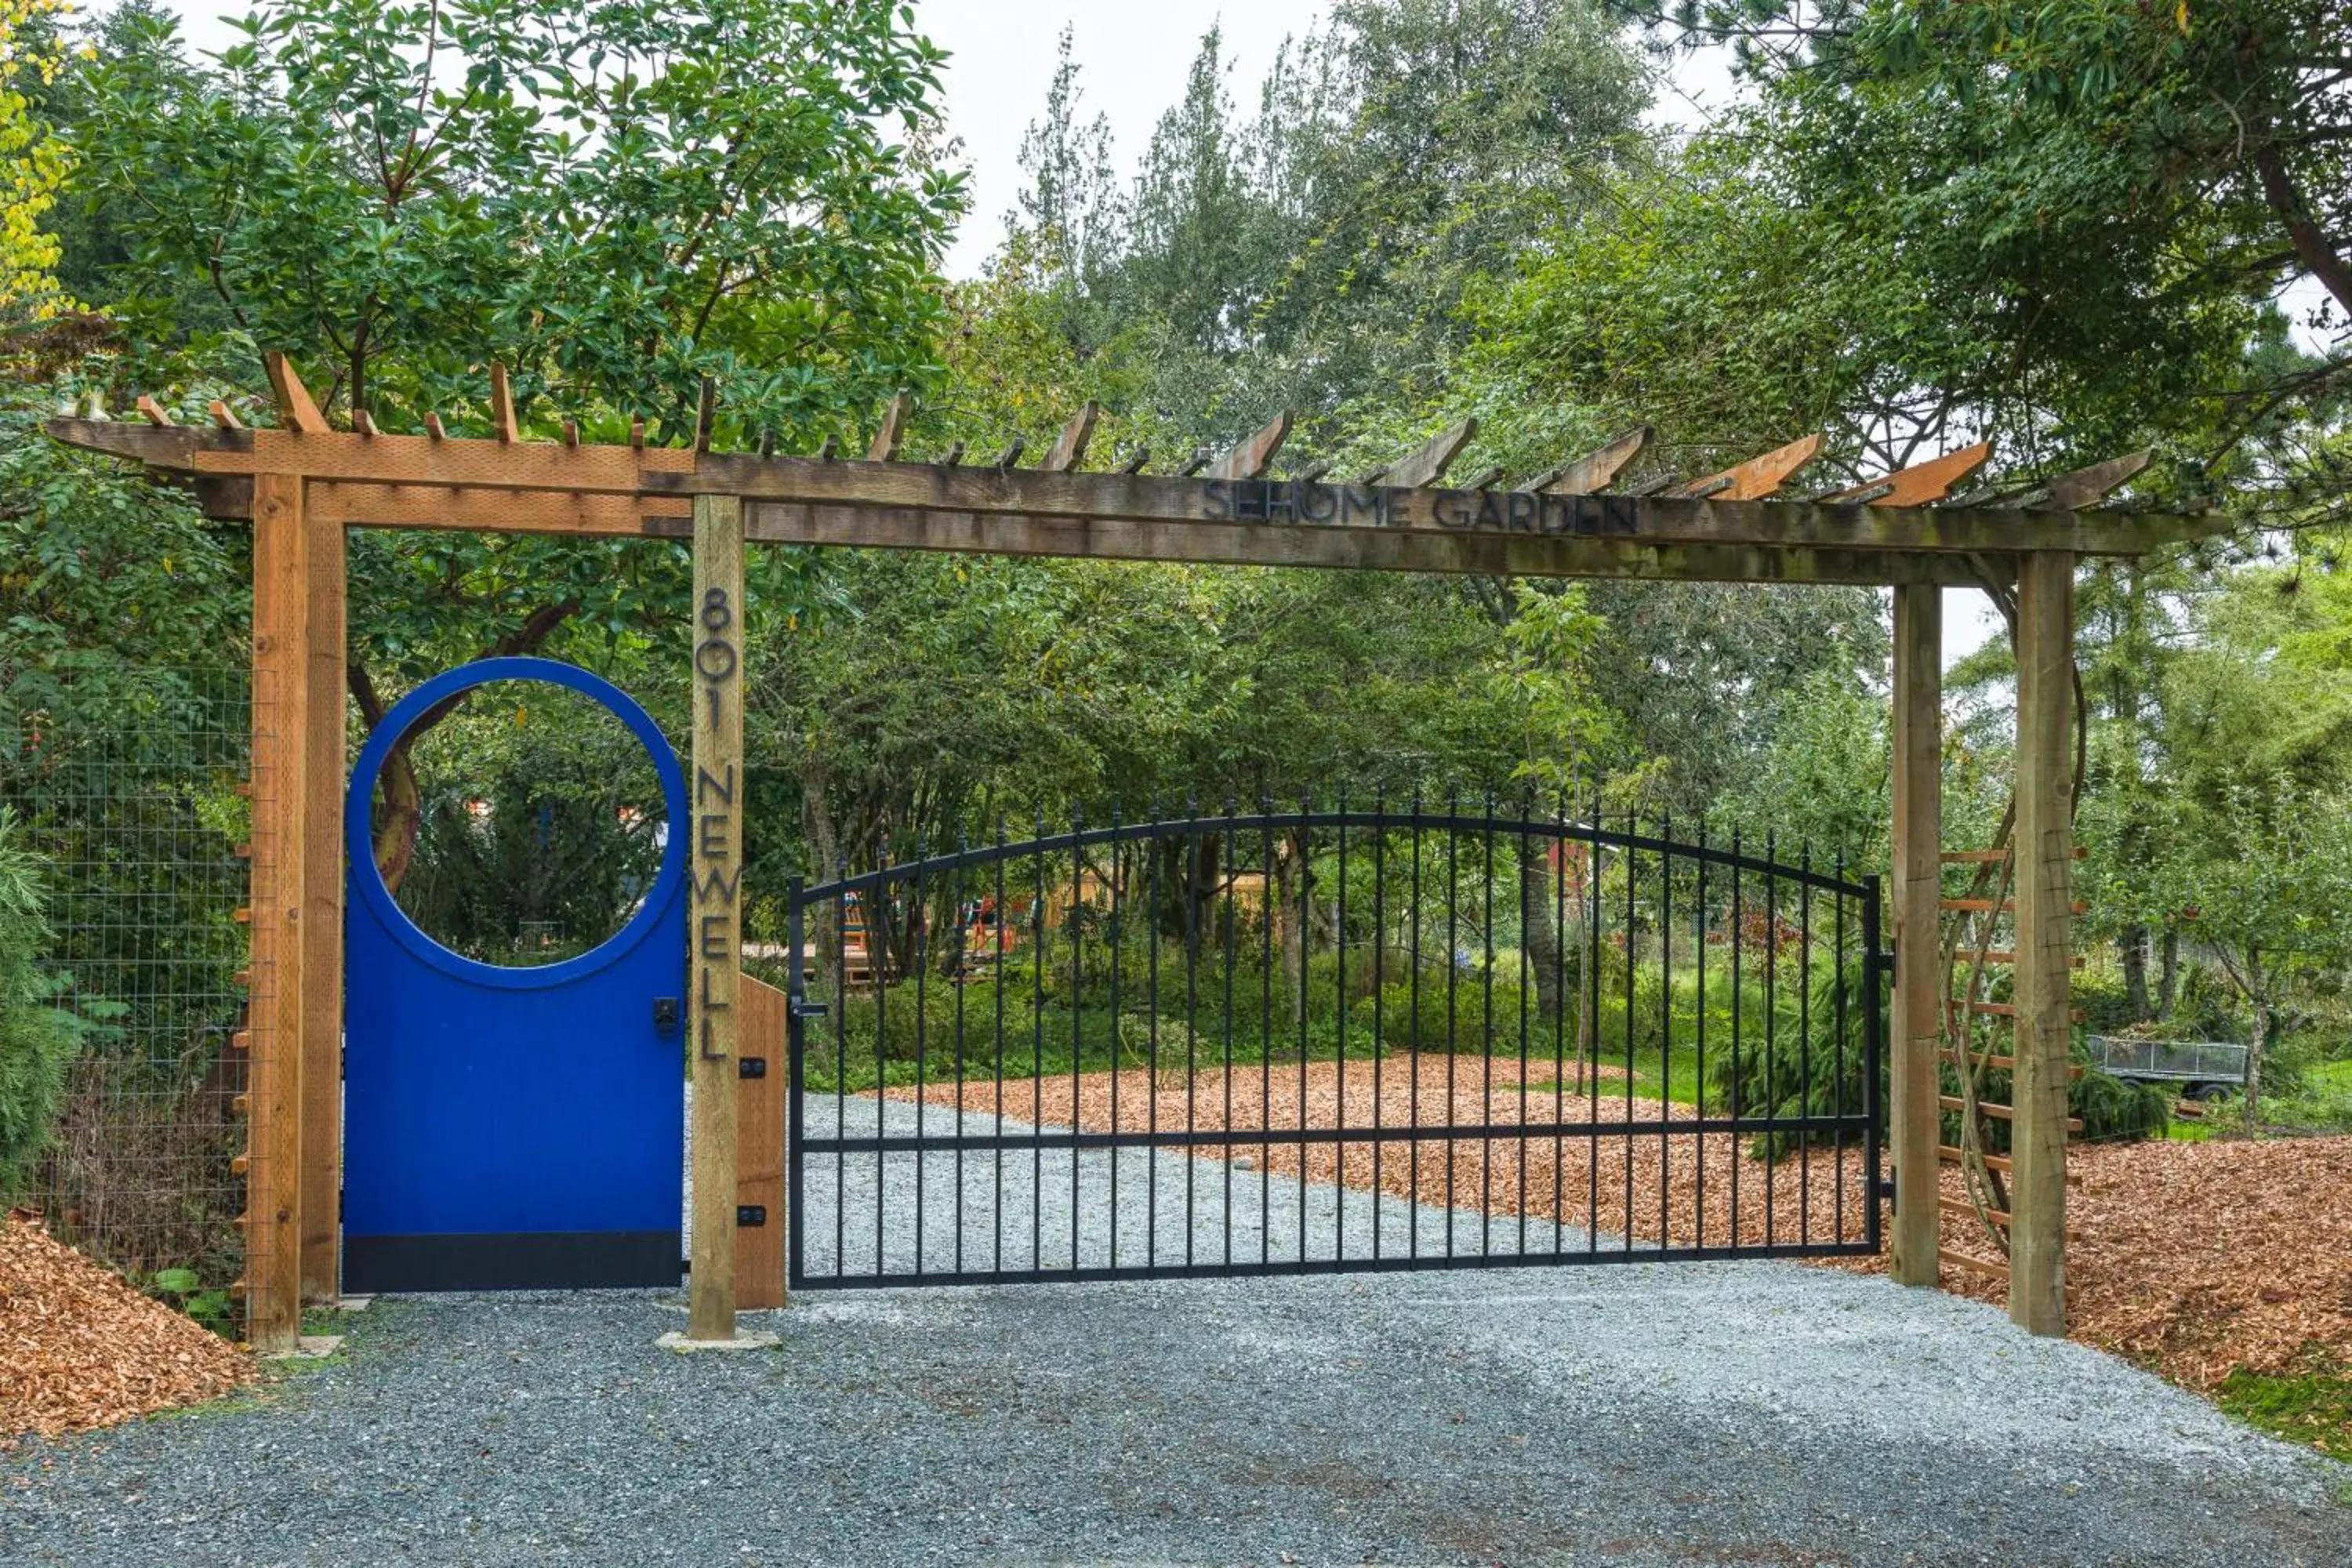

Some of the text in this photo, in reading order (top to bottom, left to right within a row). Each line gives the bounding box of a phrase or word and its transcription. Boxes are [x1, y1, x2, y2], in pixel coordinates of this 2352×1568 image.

[1203, 478, 1638, 534] SEHOME GARDEN
[691, 588, 742, 1060] 801 NEWELL
